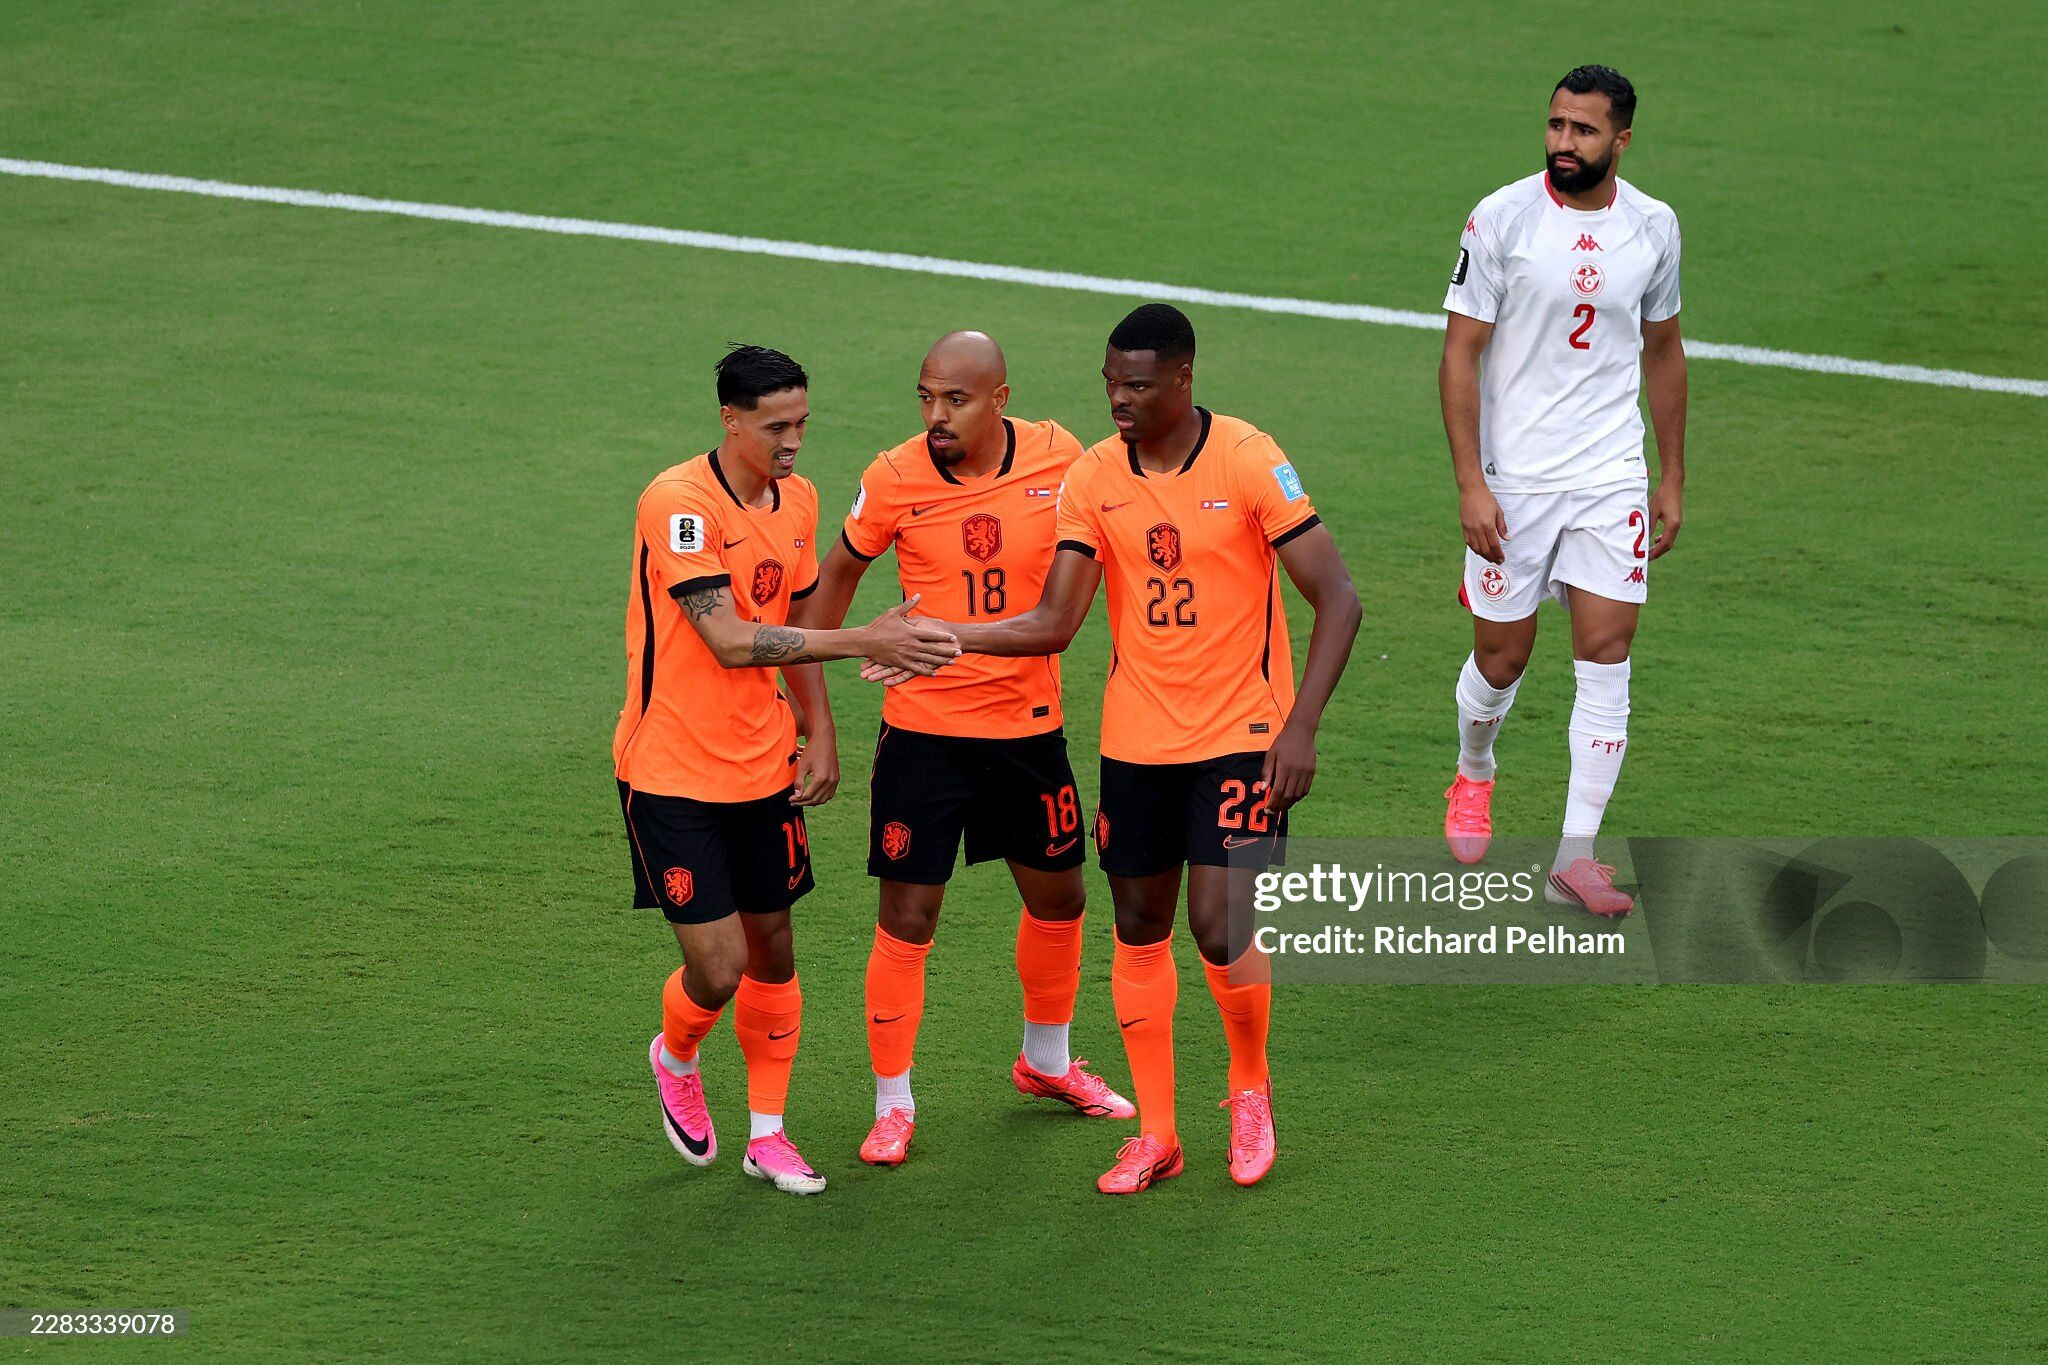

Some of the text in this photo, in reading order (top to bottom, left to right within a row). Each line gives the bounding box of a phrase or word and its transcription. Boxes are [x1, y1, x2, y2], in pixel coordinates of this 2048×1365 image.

[1568, 303, 1596, 350] 2
[1628, 510, 1646, 559] 2
[961, 566, 1007, 616] 18
[1146, 577, 1198, 627] 22
[1472, 713, 1503, 727] FTF
[1591, 739, 1626, 754] FTF
[1040, 784, 1078, 838] 18
[1217, 779, 1272, 833] 22
[782, 815, 809, 869] 14
